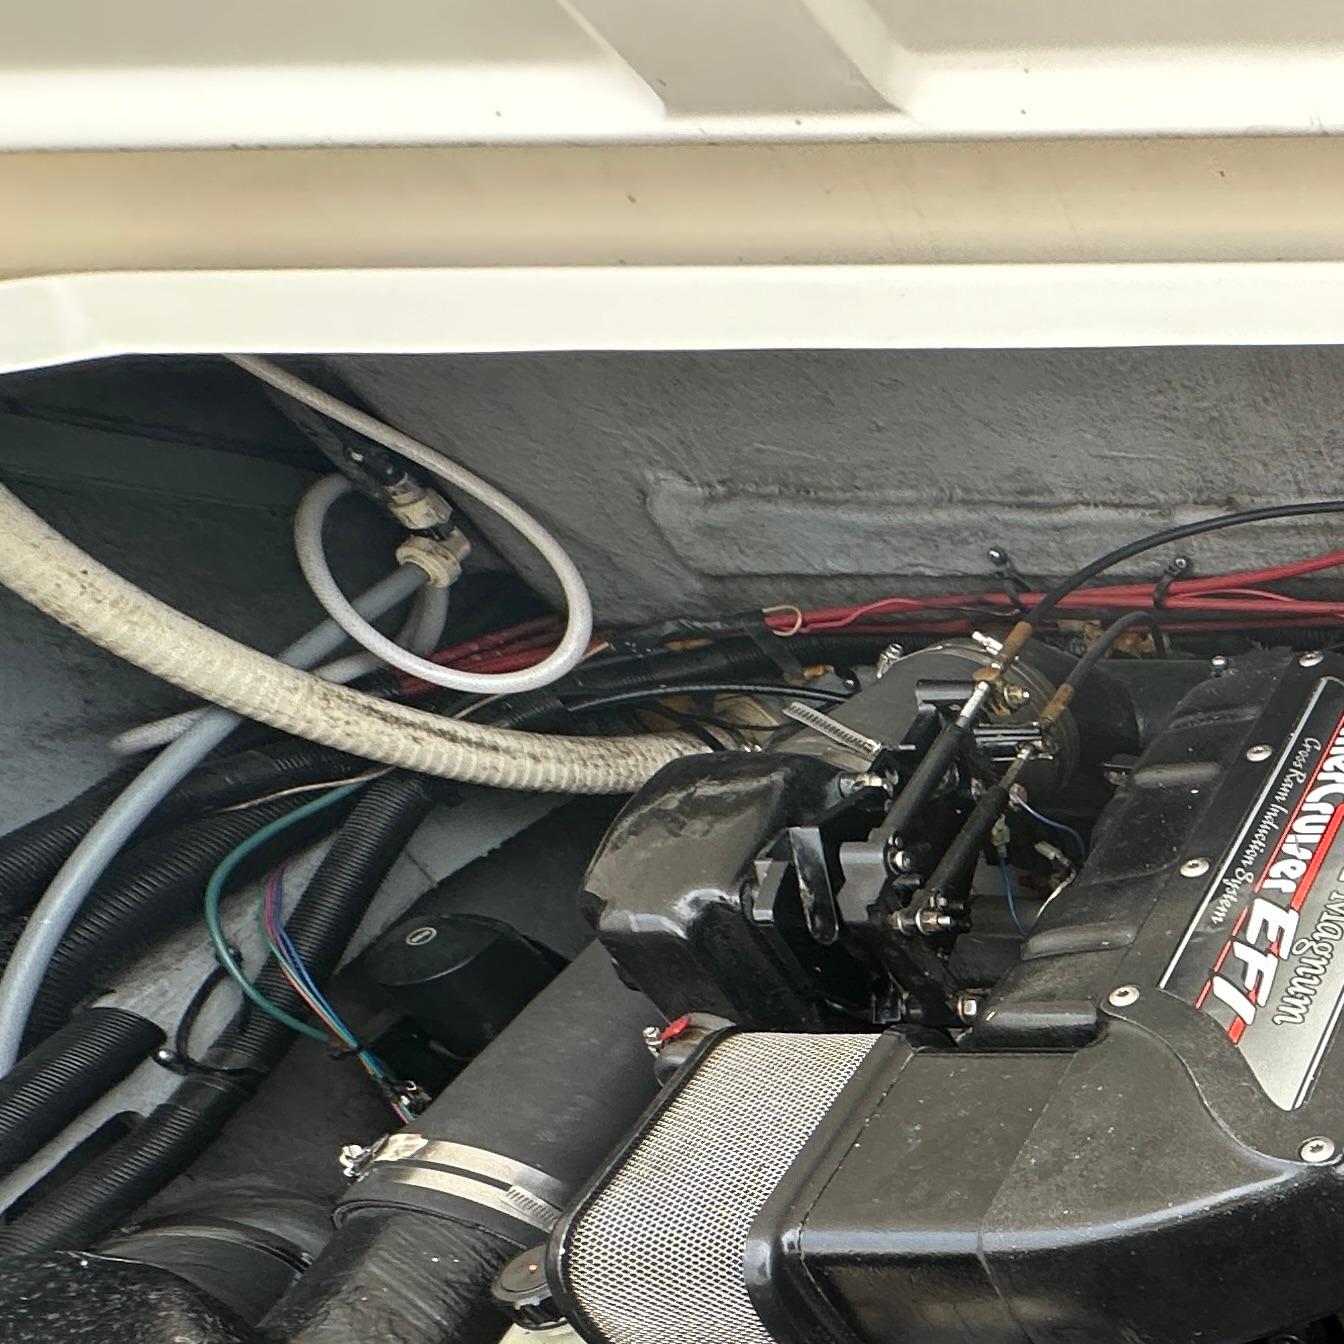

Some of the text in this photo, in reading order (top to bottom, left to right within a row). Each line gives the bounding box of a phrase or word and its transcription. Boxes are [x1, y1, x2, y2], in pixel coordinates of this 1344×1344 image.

[1210, 737, 1322, 926] Cross Ram Induction System
[1212, 894, 1300, 1026] EFI
